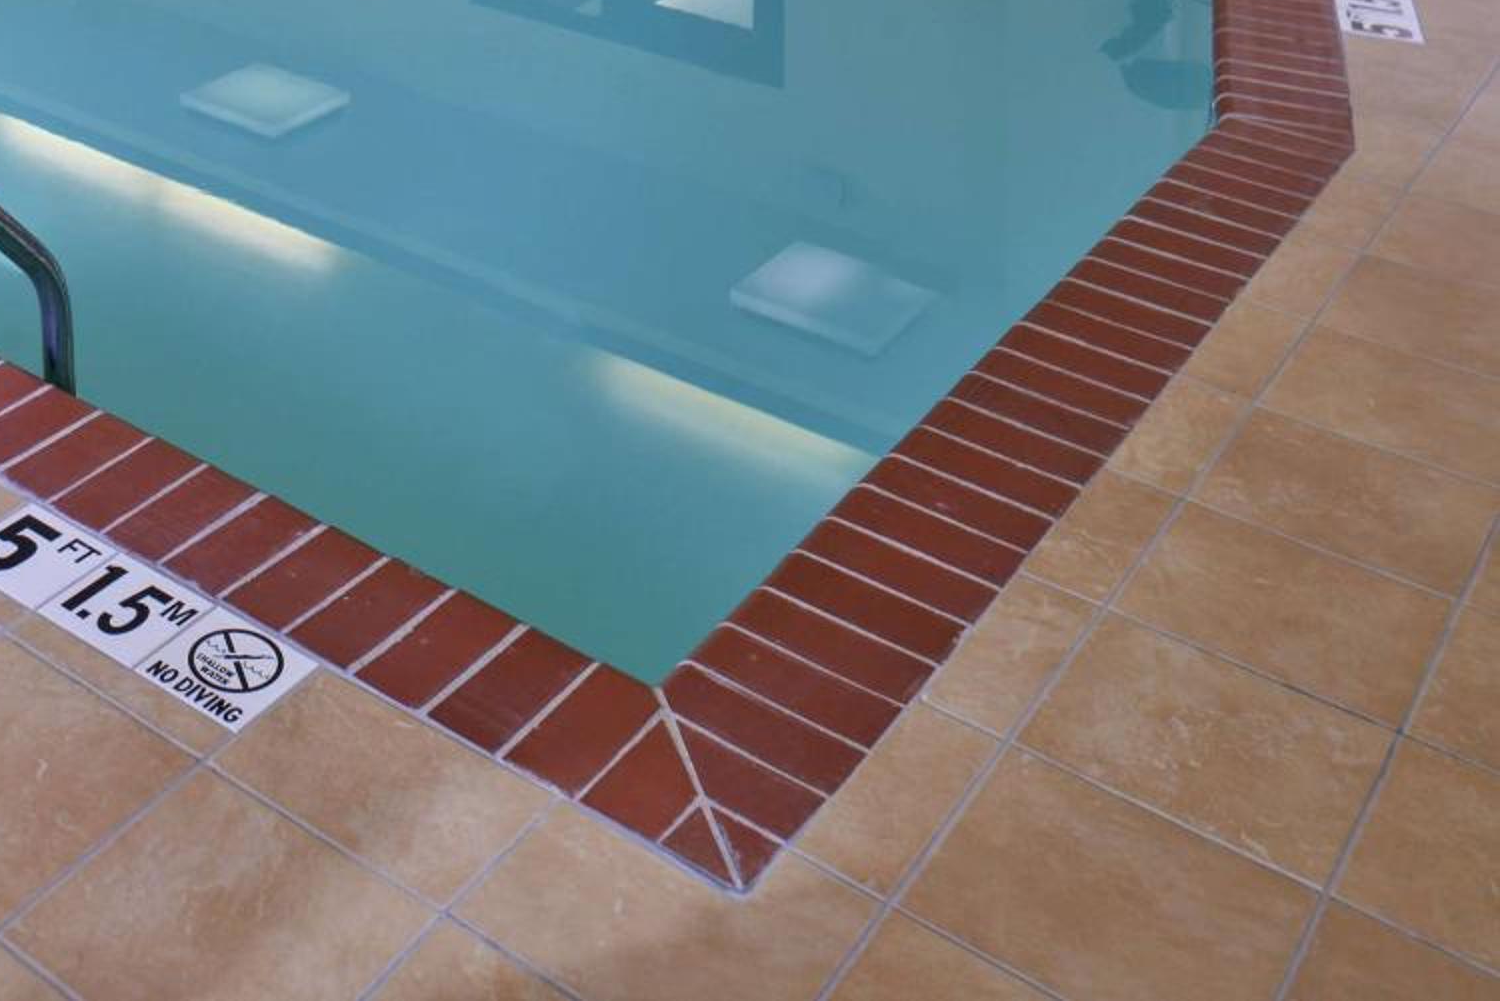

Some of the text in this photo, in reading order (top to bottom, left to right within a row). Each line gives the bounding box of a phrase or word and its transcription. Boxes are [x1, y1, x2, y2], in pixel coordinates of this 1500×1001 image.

[56, 538, 103, 564] FT
[61, 565, 174, 636] 1.5
[159, 600, 200, 627] M
[196, 652, 236, 678] SHALLOW
[200, 665, 230, 686] WATER
[145, 659, 244, 724] NO DIVING
